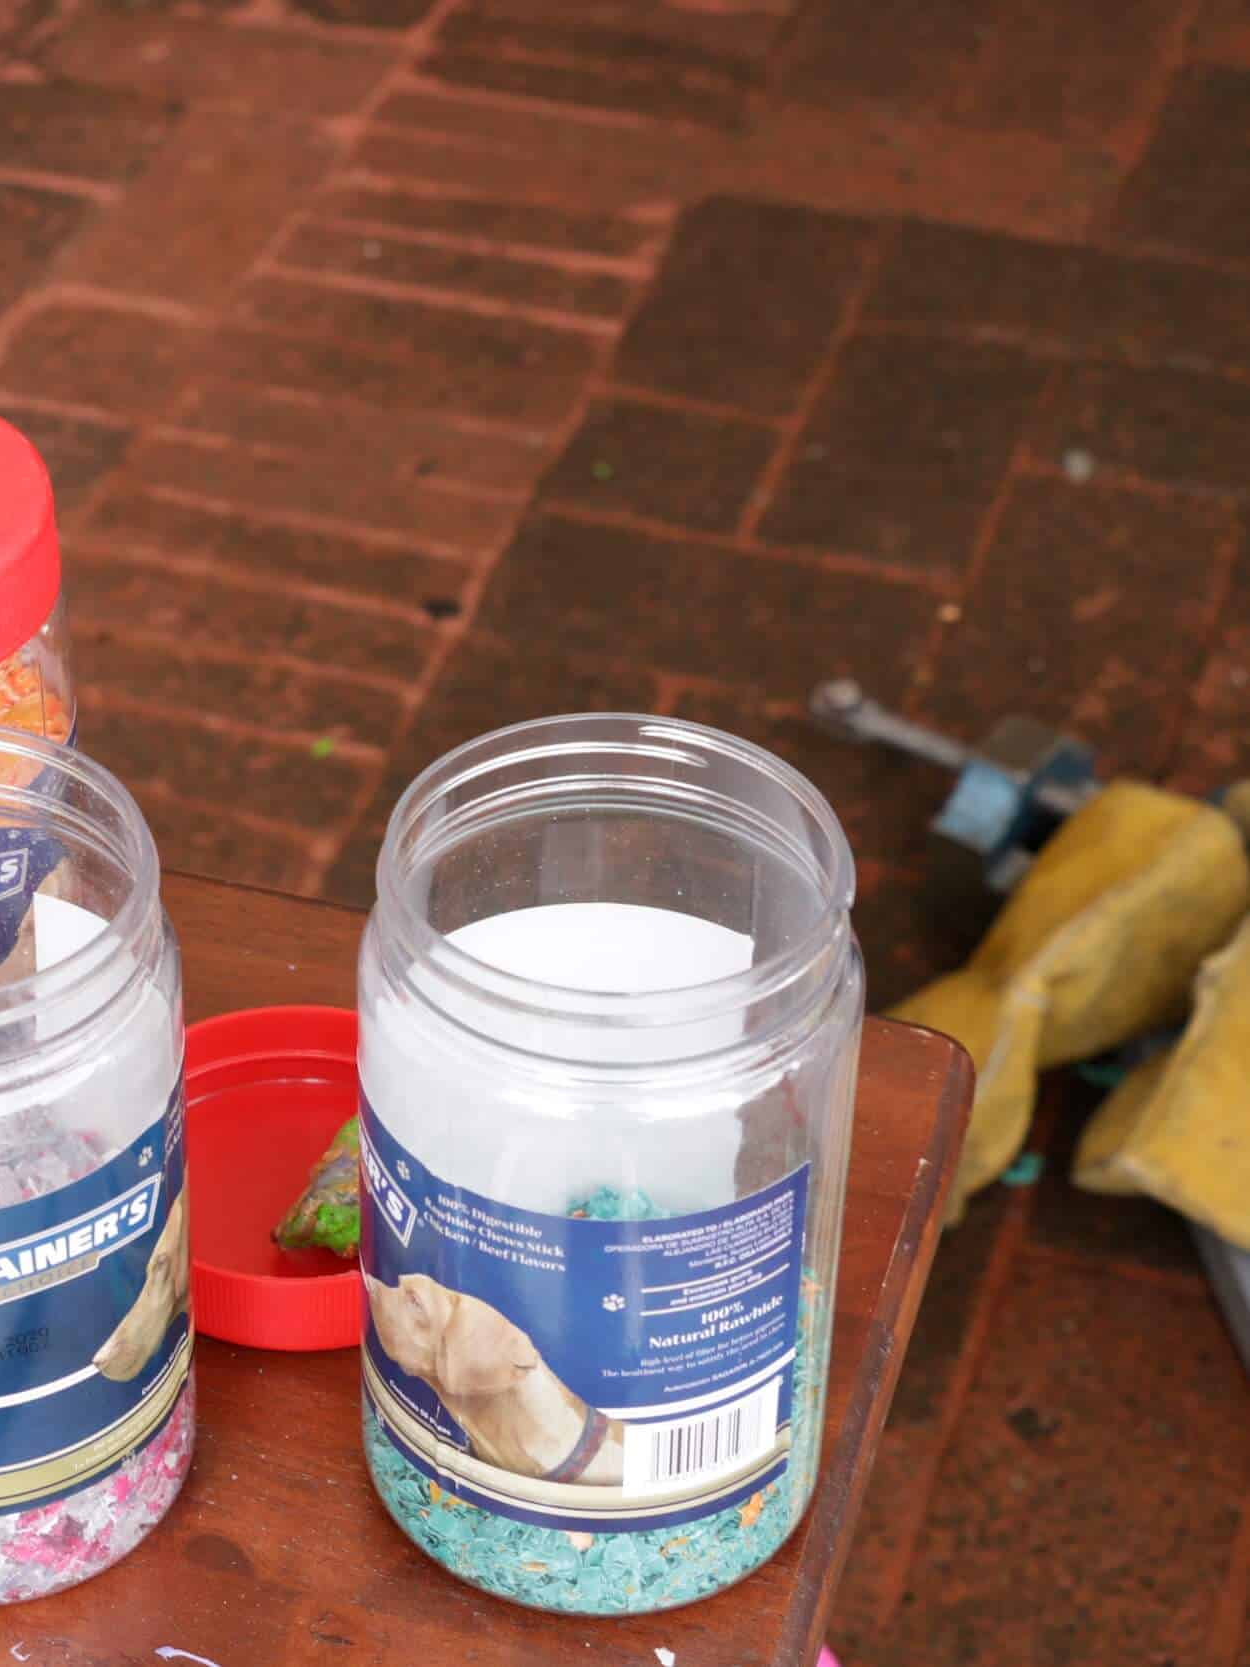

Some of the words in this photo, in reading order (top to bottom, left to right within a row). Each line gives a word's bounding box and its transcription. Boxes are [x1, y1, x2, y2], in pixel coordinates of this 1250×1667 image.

[423, 1211, 470, 1245] Chicken
[478, 1239, 510, 1261] Beef
[511, 1251, 567, 1273] Flavors
[424, 1196, 478, 1232] Rawhide
[478, 1226, 526, 1249] Chews
[527, 1240, 566, 1258] Stick
[472, 1207, 543, 1239] Digestible
[648, 1323, 716, 1350] Natural
[718, 1294, 785, 1330] Rawhide
[701, 1299, 745, 1325] 100%
